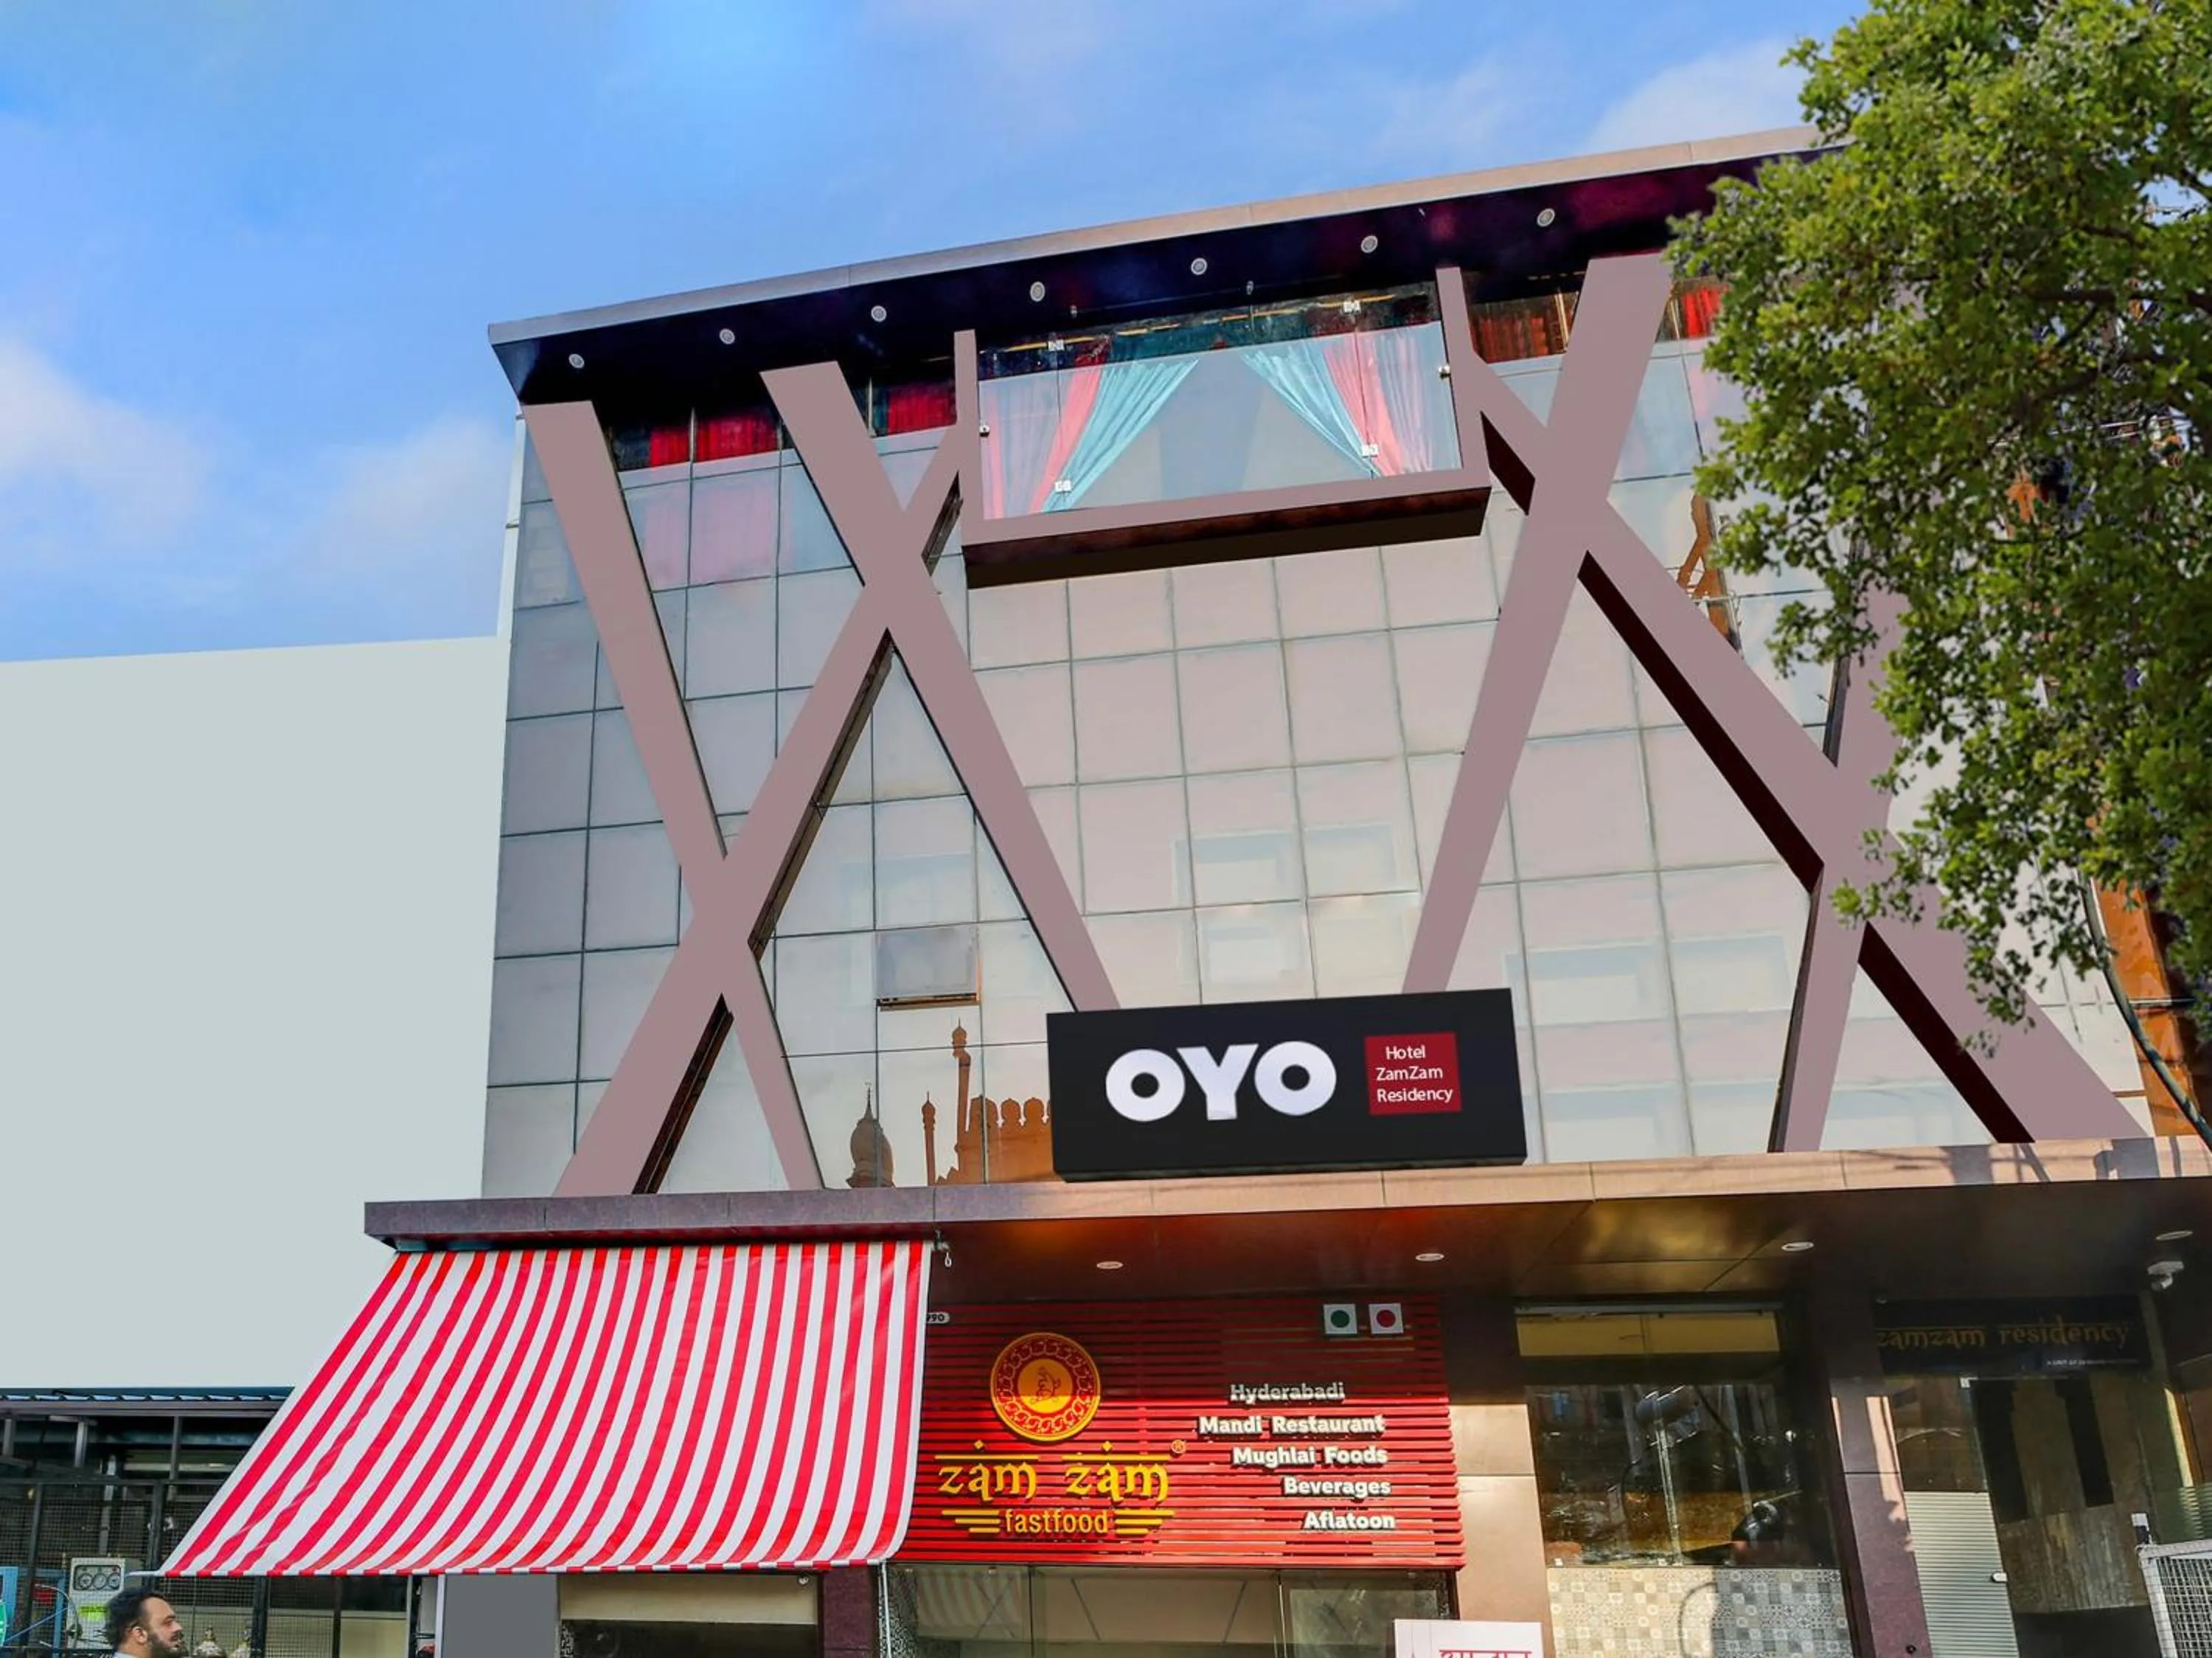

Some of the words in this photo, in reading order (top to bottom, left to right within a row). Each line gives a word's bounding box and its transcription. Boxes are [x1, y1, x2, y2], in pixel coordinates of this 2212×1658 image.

[1385, 1044, 1426, 1060] Hotel
[1106, 1041, 1336, 1122] OYO
[1375, 1066, 1444, 1081] ZamZam
[1376, 1088, 1453, 1103] Residency
[1998, 1315, 2129, 1350] residency
[1230, 1382, 1345, 1404] Hyderabadi
[1199, 1415, 1262, 1434] Mandi
[1271, 1414, 1385, 1433] Restaurant
[1233, 1446, 1315, 1468] Mughlai
[1324, 1445, 1388, 1464] Foods
[1283, 1476, 1391, 1499] Beverages
[1005, 1509, 1108, 1534] fastfood
[1304, 1510, 1396, 1530] Aflatoon
